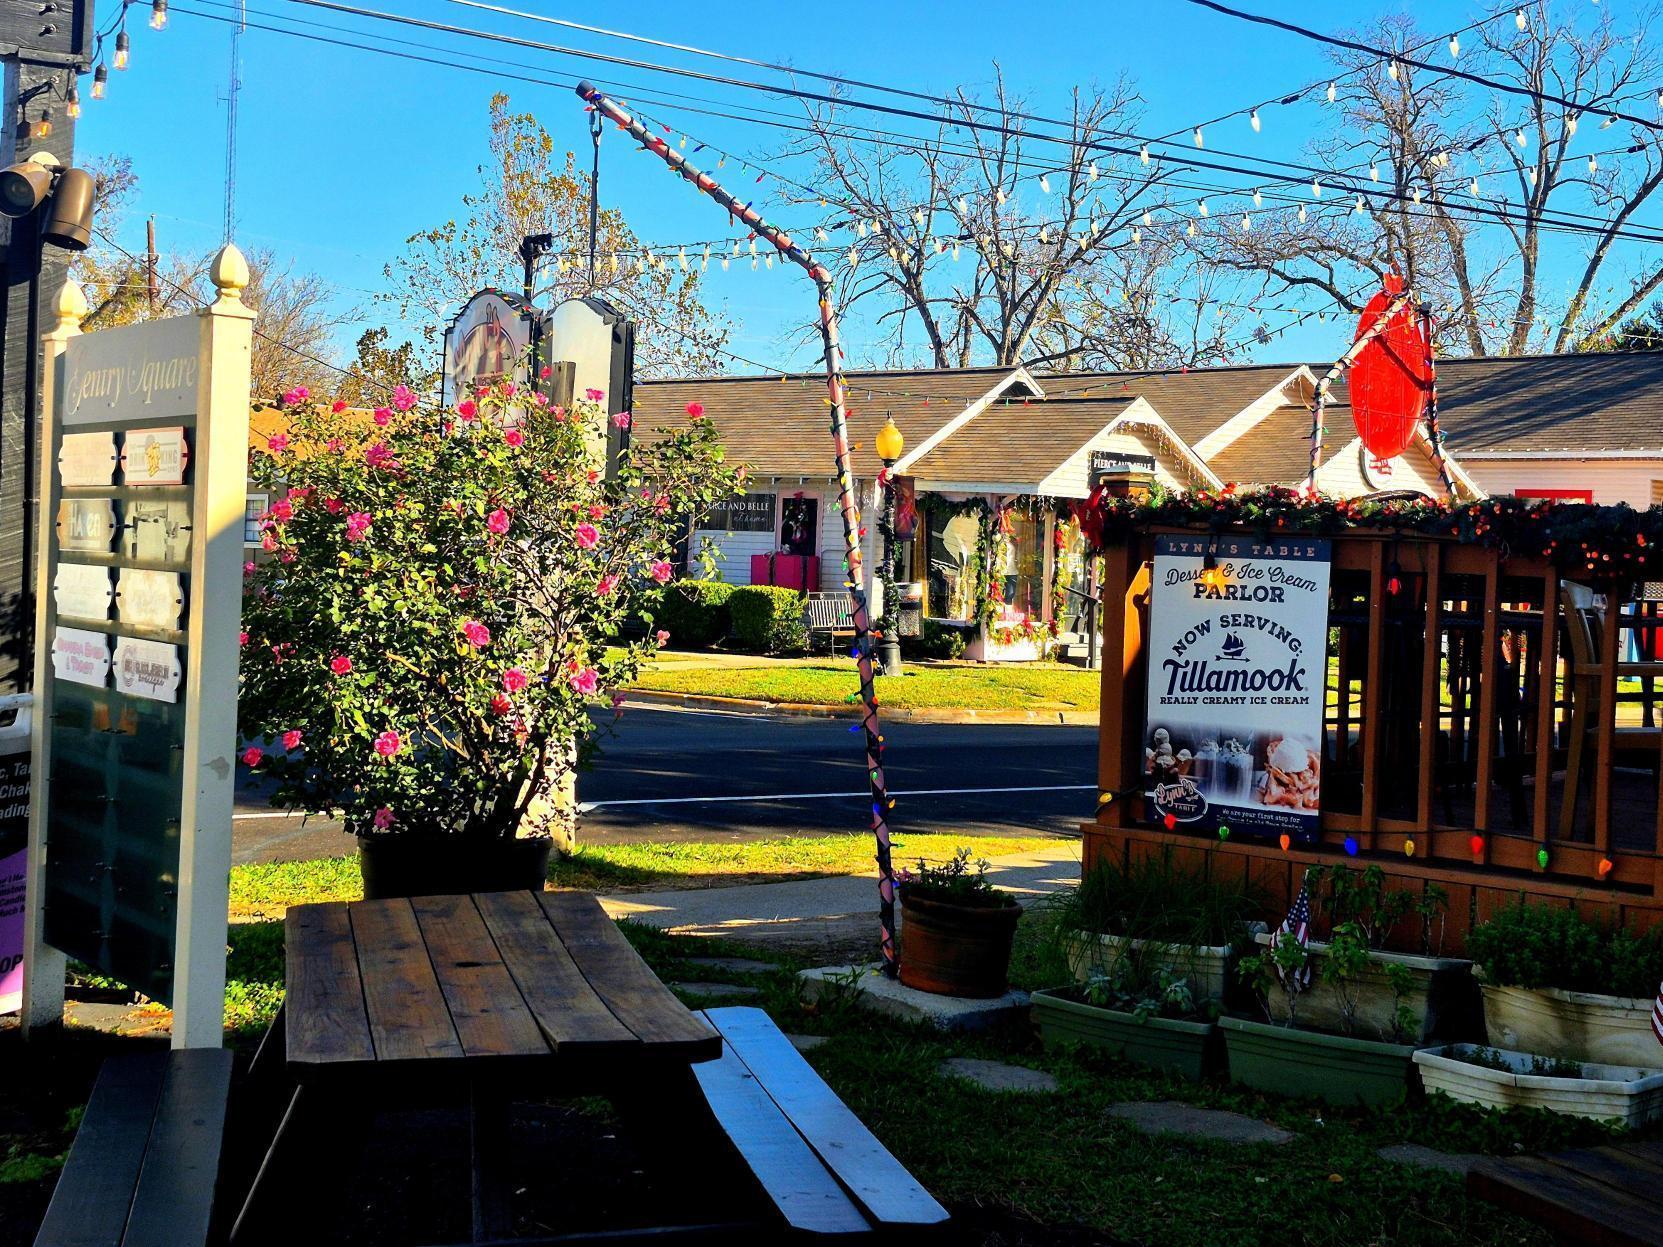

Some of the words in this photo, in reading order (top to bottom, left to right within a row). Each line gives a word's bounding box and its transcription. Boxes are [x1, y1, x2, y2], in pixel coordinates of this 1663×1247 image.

[705, 501, 727, 510] ERCE
[728, 502, 746, 511] AND
[747, 502, 769, 511] BELLE
[1169, 543, 1238, 554] LYNN'S
[1252, 545, 1315, 557] TABLE
[1165, 568, 1216, 586] Desse
[1222, 563, 1235, 577] &
[1237, 563, 1264, 580] Ice
[1268, 566, 1317, 592] Cream
[1193, 582, 1285, 603] PARLOR
[1172, 619, 1212, 657] NOW
[1163, 658, 1307, 695] Tillamook
[1160, 696, 1199, 705] REALLY
[1202, 696, 1247, 705] CREAMY
[1250, 696, 1267, 705] ICE
[1270, 696, 1310, 705] CREAM
[1158, 780, 1194, 807] Lynn's
[1257, 812, 1273, 820] first
